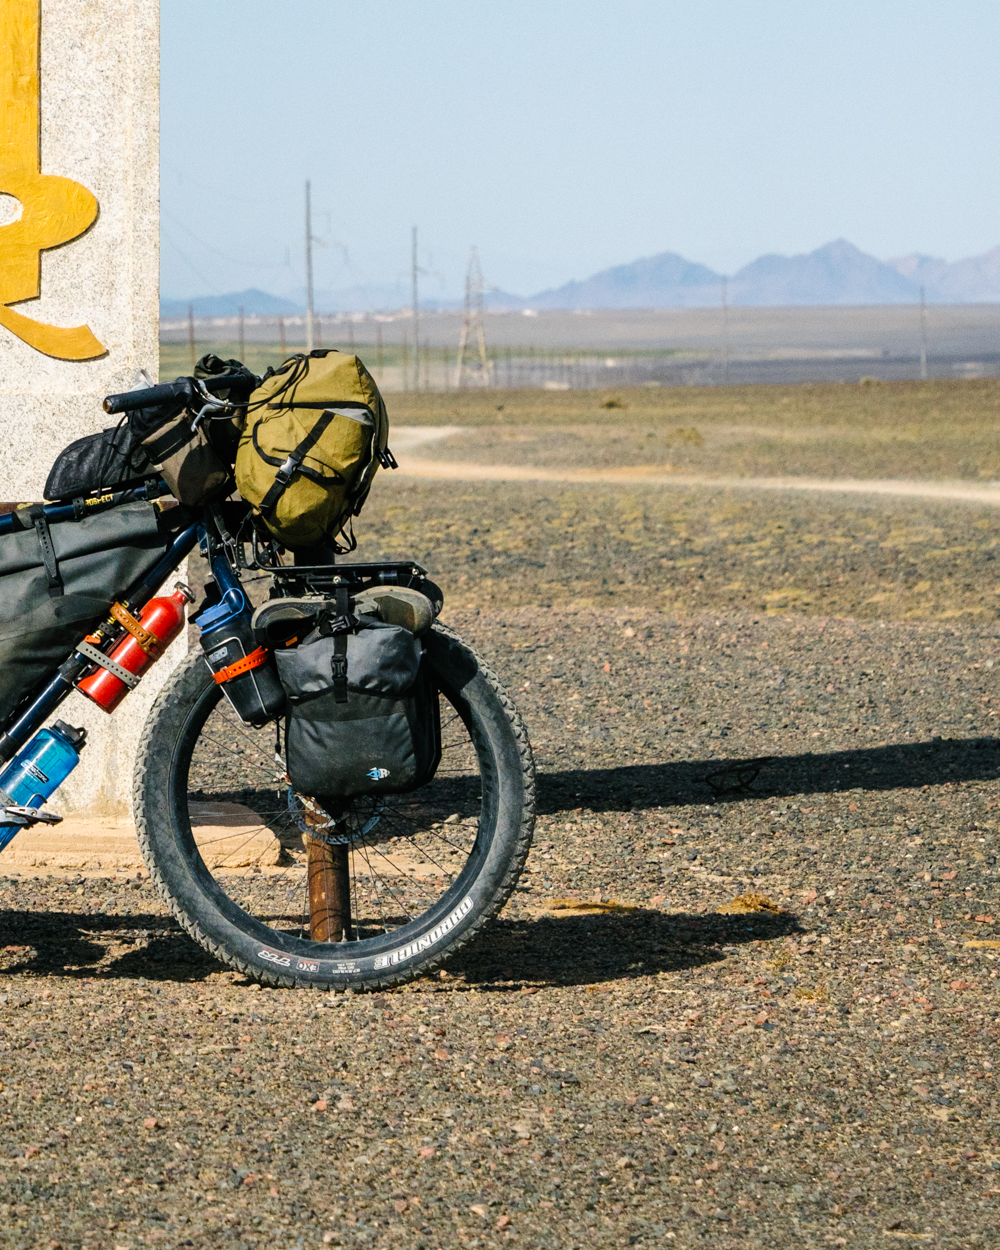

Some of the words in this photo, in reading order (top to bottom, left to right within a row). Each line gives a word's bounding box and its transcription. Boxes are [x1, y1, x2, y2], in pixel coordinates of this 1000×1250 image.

[85, 493, 114, 506] ROSPECT
[374, 896, 474, 970] CHRONICLE
[297, 962, 318, 971] EXO
